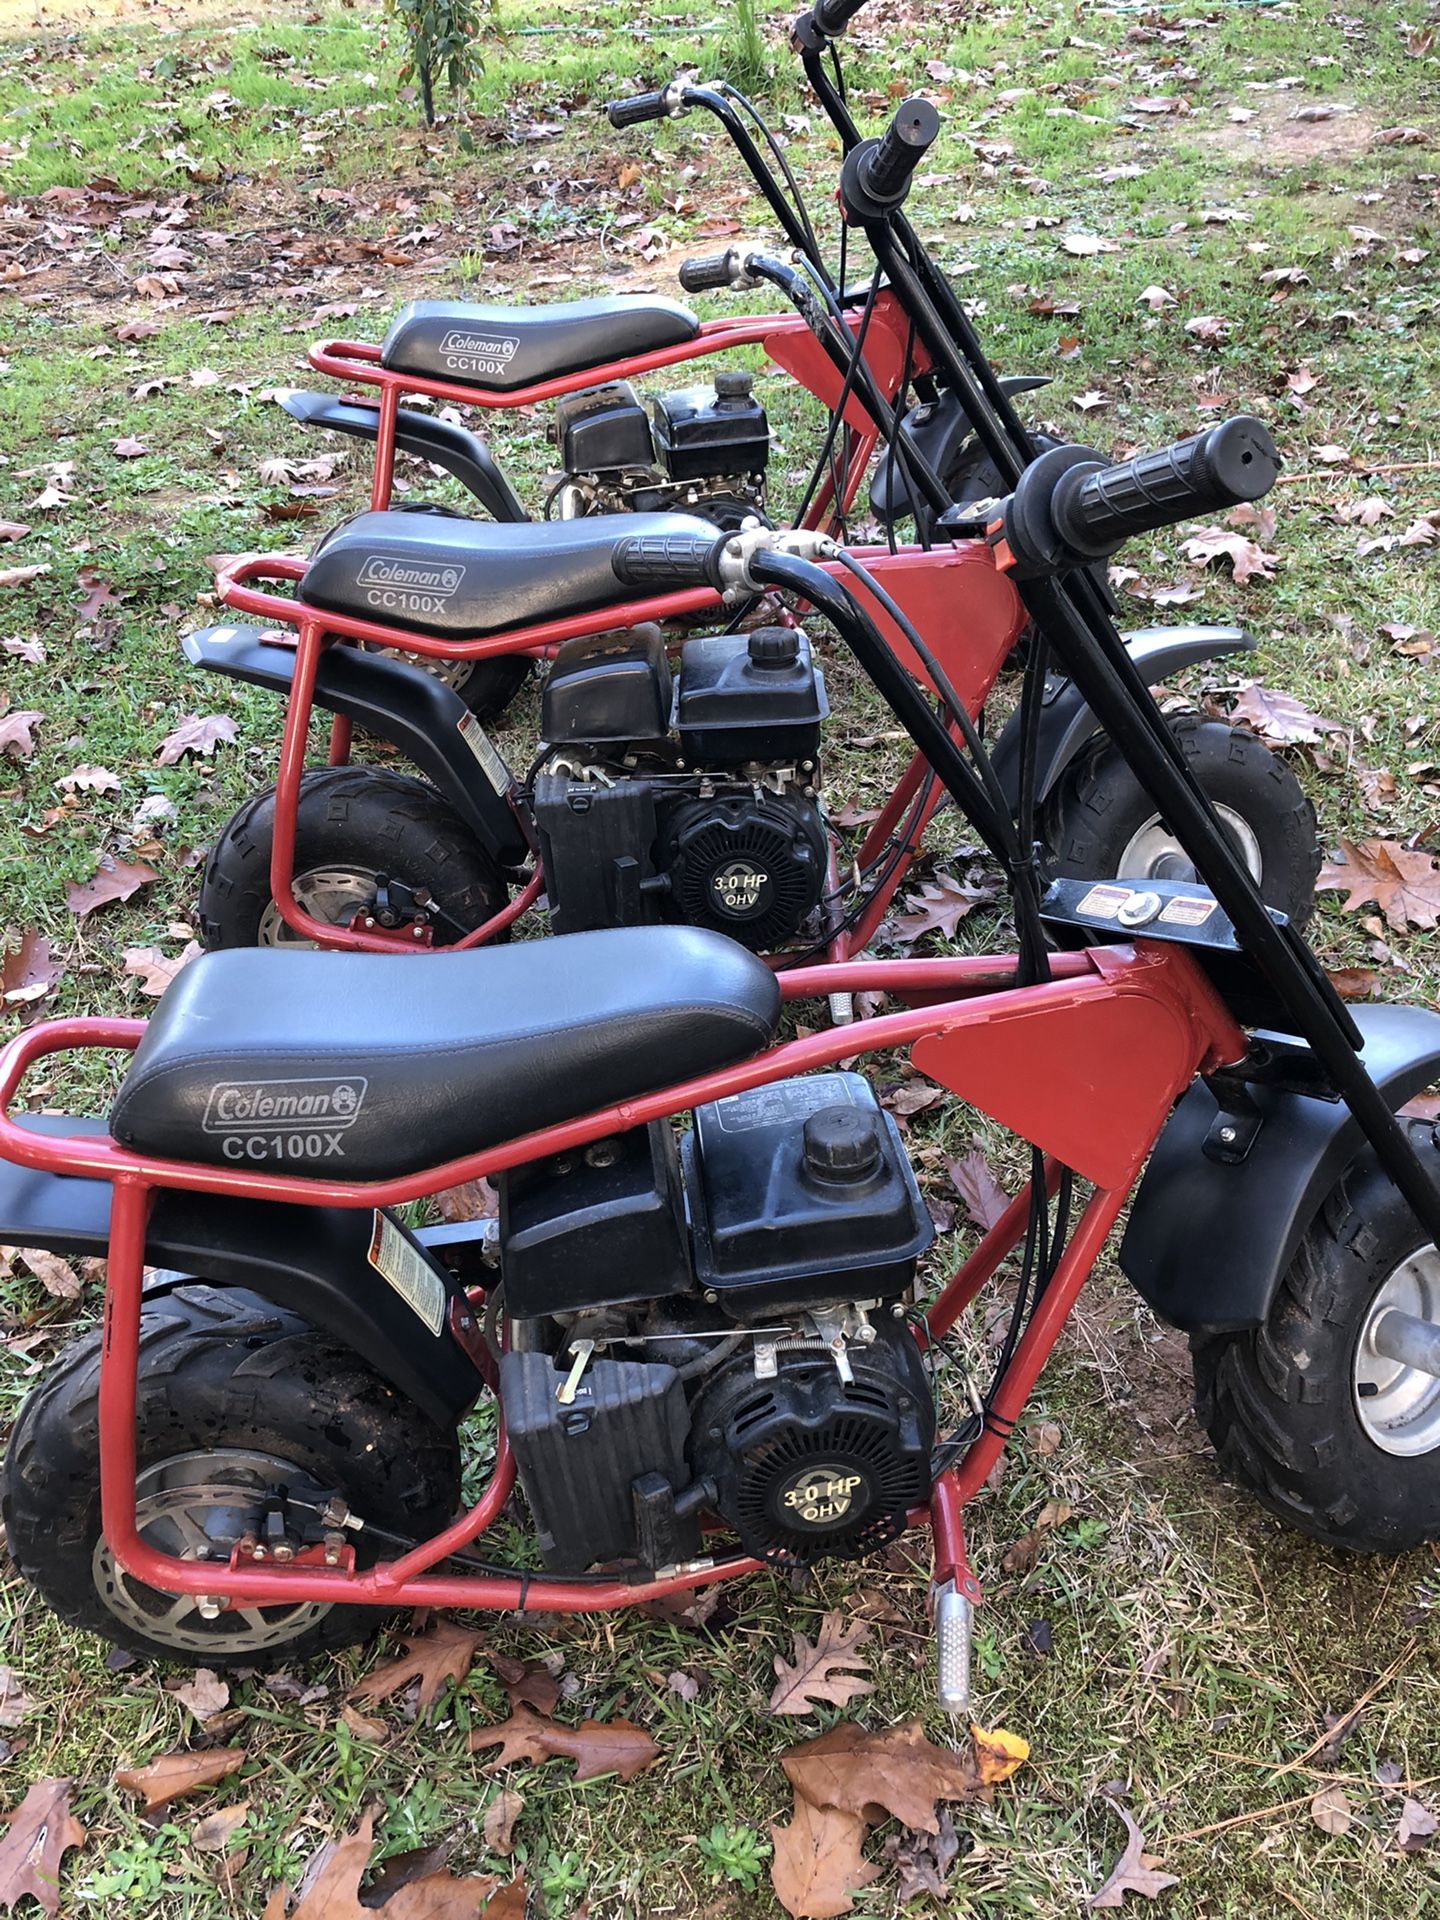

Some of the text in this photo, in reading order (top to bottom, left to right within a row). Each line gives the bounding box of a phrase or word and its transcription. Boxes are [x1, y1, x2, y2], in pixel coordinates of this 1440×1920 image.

[448, 334, 502, 353] Coleman
[446, 356, 506, 375] CC100X
[368, 560, 441, 585] Coleman
[367, 590, 446, 614] CC100X
[714, 874, 768, 890] 3.0 HP
[725, 893, 757, 905] OHV
[217, 1088, 330, 1120] Coleman
[222, 1132, 345, 1160] CC100X
[784, 1475, 862, 1507] 3.0 HP
[803, 1500, 849, 1521] OHV
